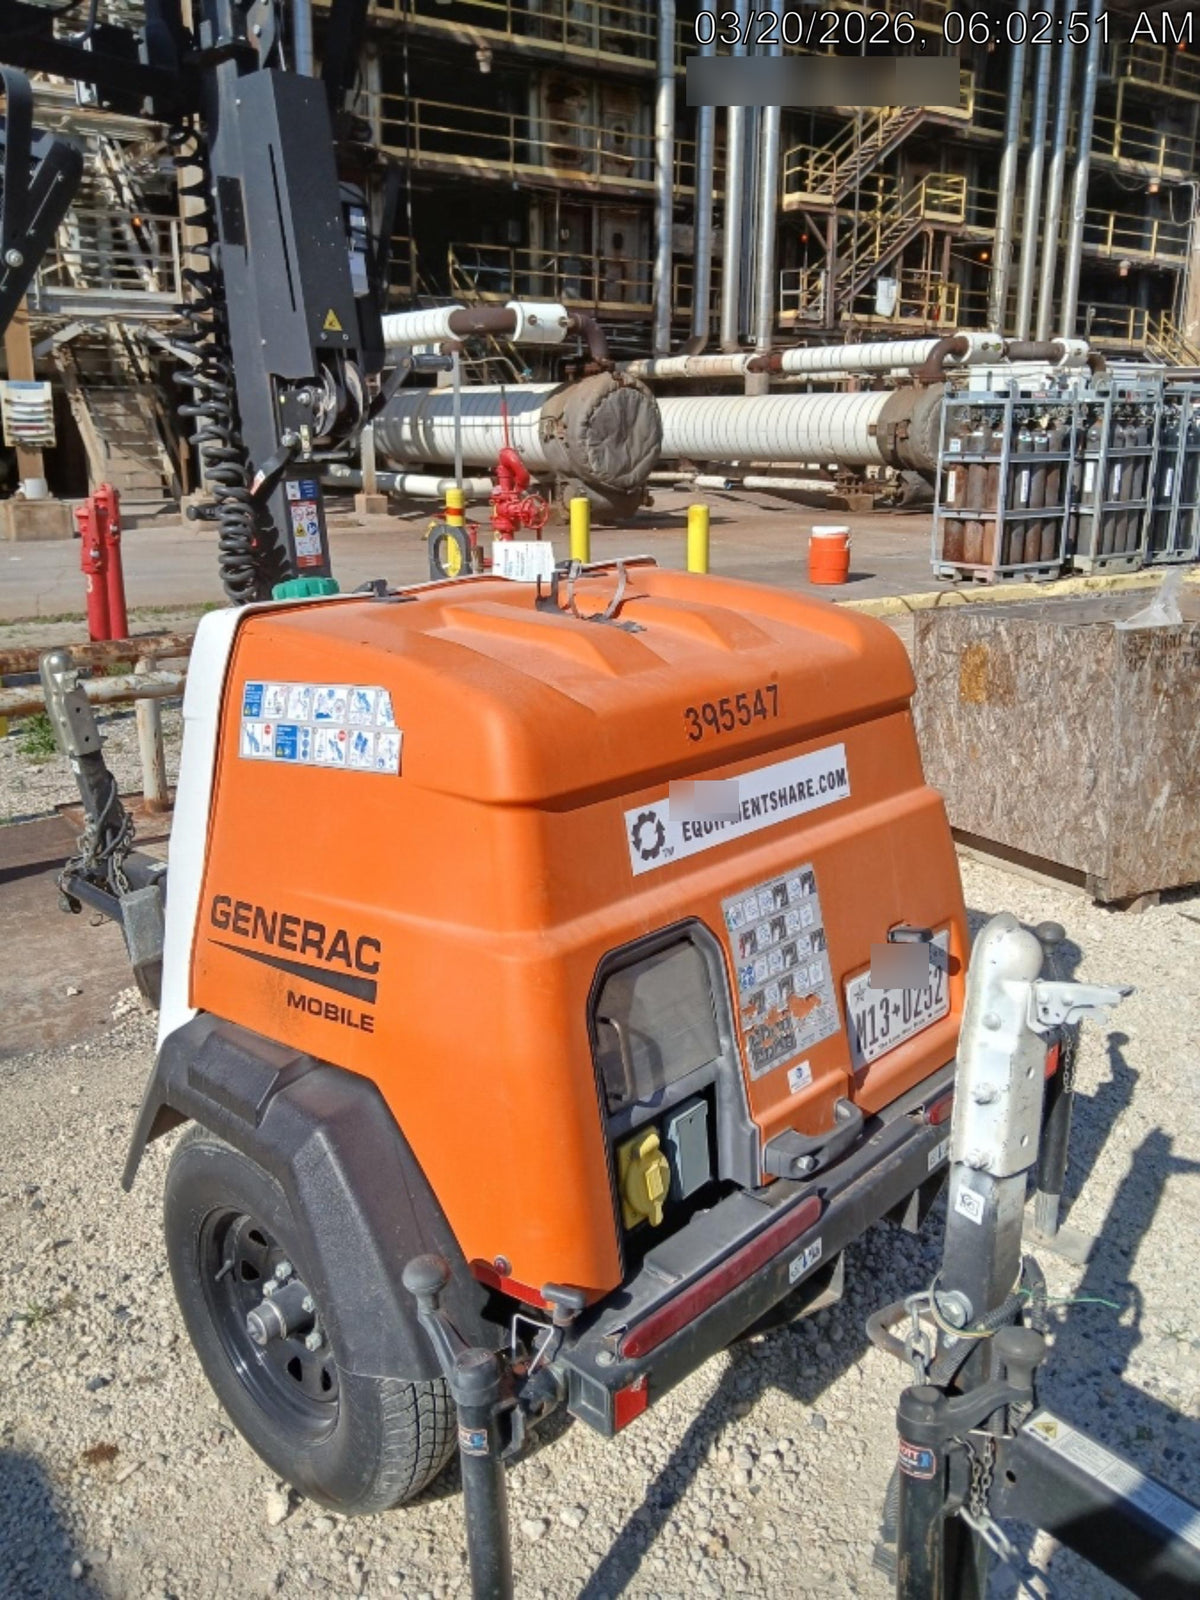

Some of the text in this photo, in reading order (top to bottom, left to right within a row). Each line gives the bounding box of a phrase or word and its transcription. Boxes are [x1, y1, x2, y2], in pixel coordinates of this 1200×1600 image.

[685, 684, 779, 742] 395547
[210, 894, 382, 975] GENERAC
[286, 989, 375, 1034] MOBILE
